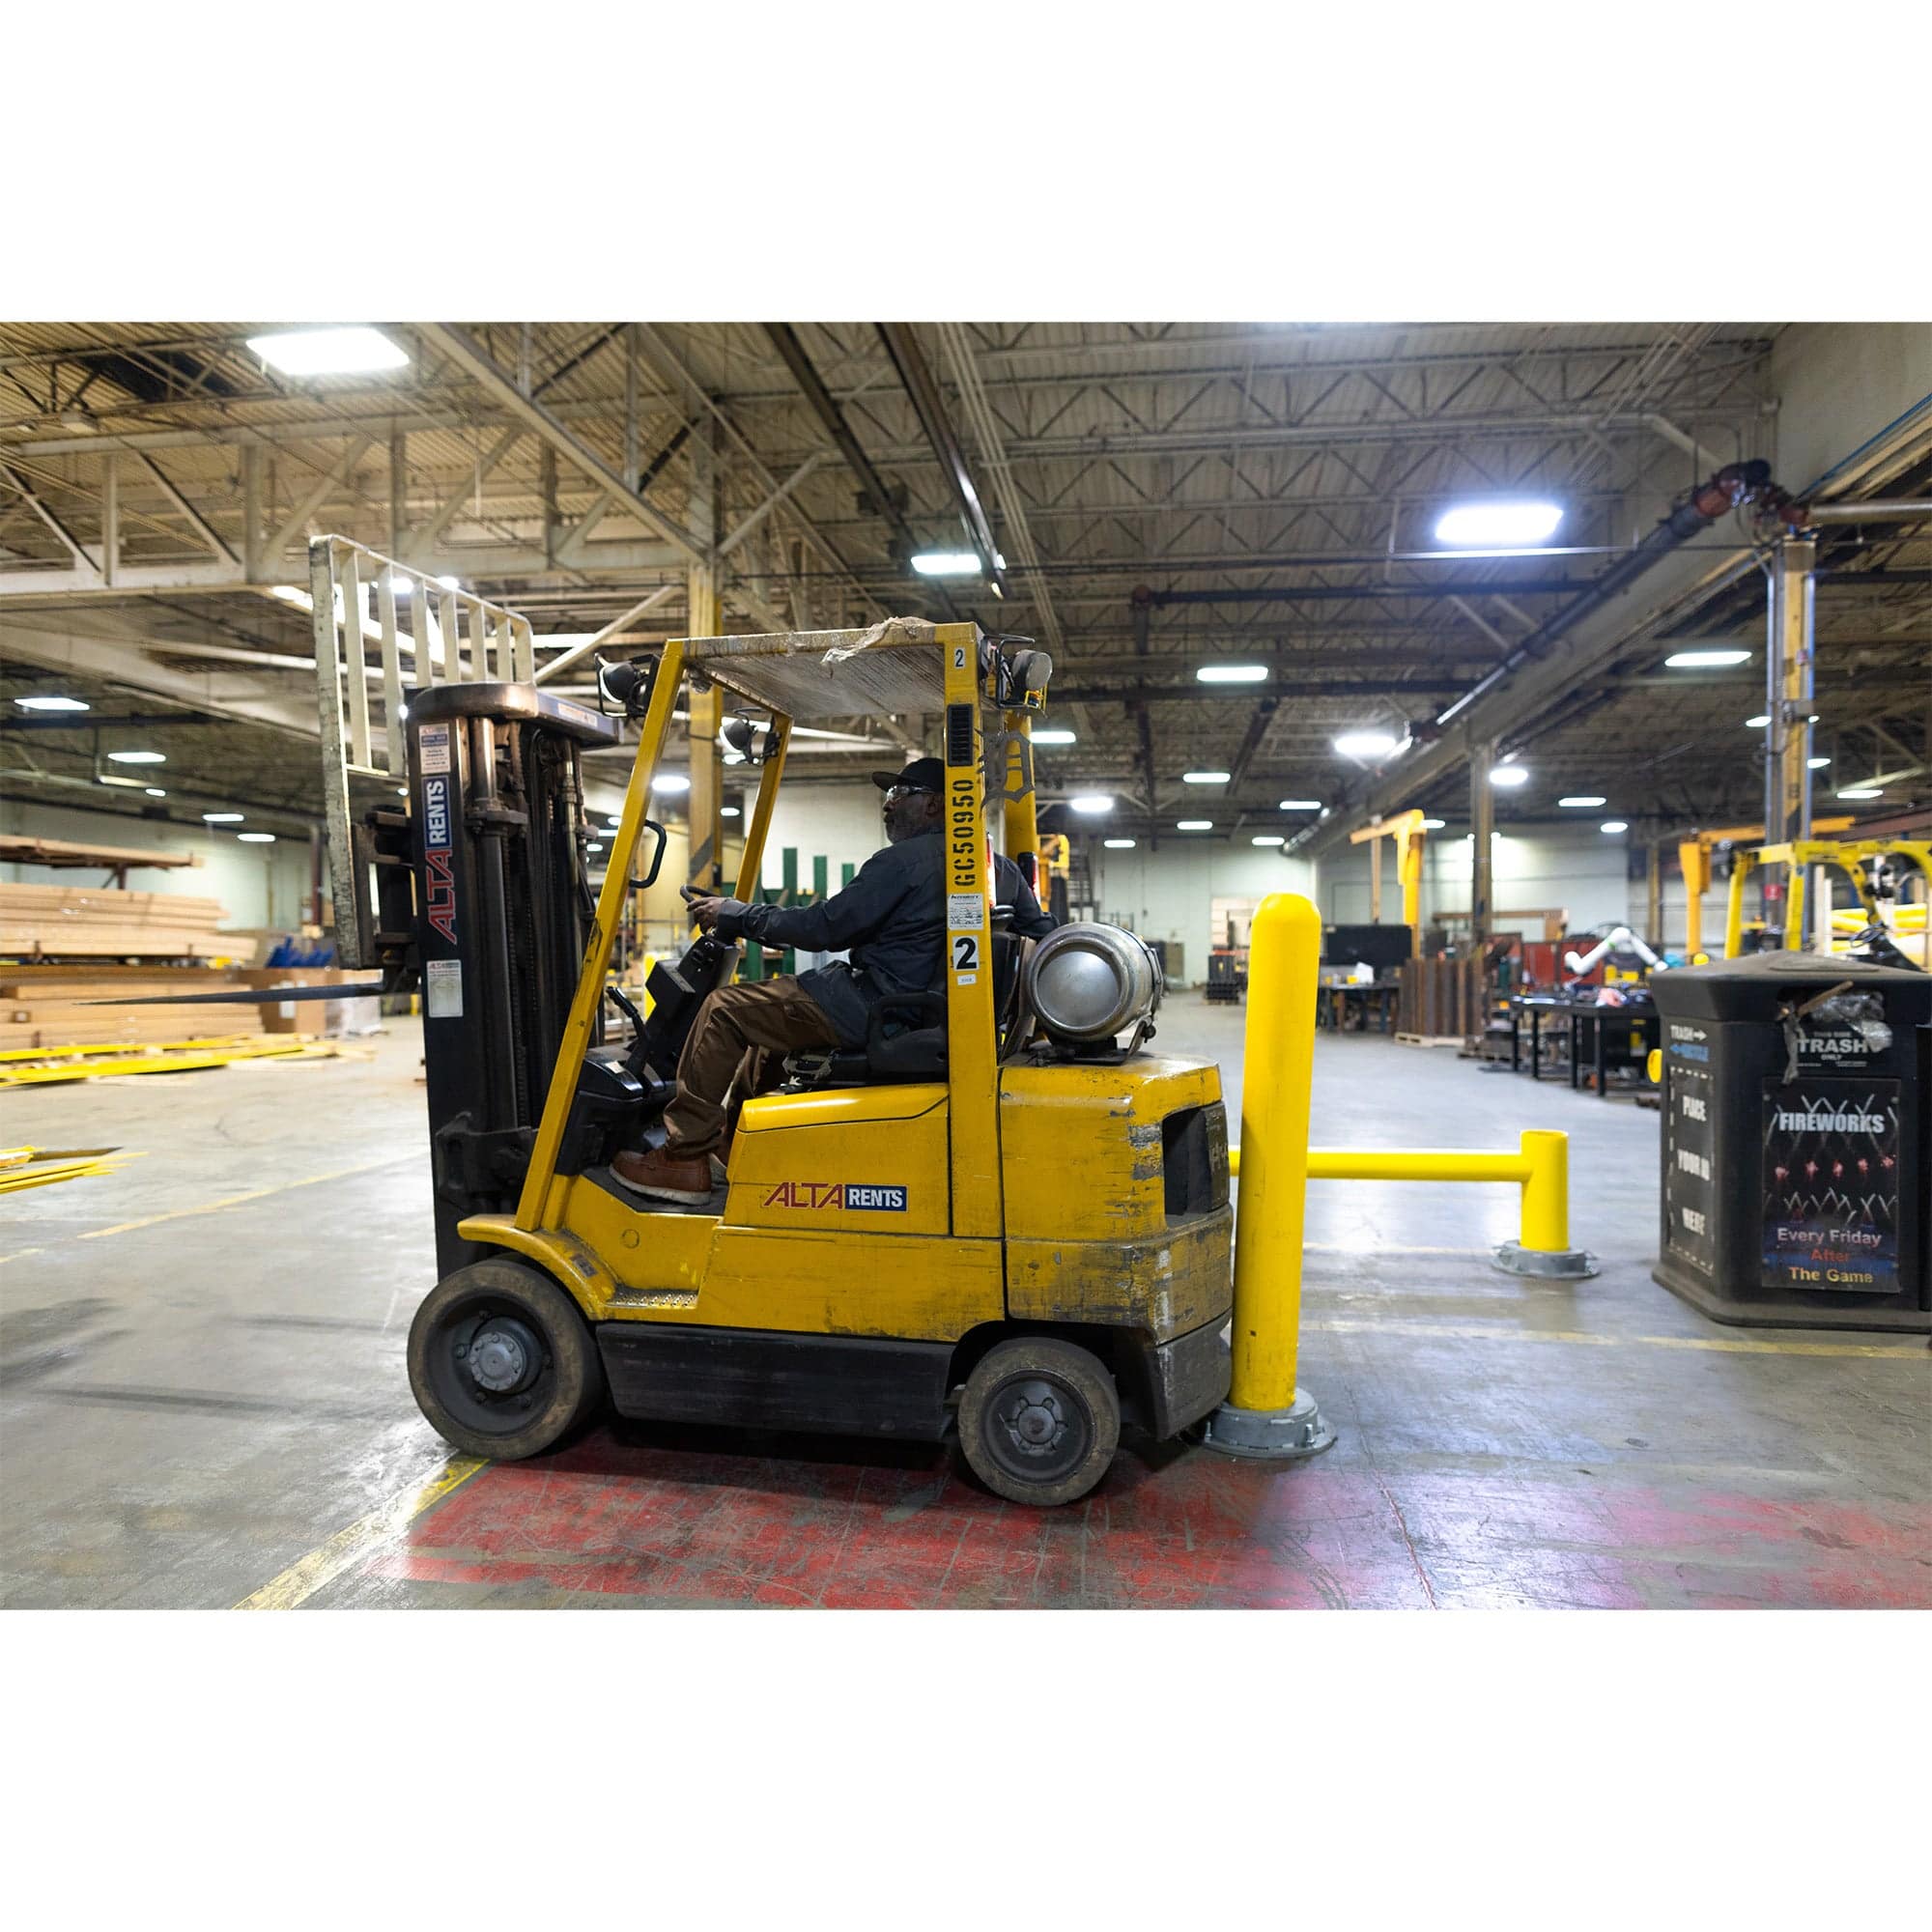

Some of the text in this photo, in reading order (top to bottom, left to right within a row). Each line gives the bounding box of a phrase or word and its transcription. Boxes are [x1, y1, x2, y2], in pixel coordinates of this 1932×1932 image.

[954, 649, 964, 667] 2
[426, 780, 446, 844] RENTS
[952, 779, 976, 887] GC50950
[425, 848, 457, 945] ALTA
[955, 937, 977, 969] 2
[1797, 1038, 1867, 1053] TRASH
[1778, 1113, 1886, 1133] FIREWORKS
[763, 1181, 903, 1209] ALTA RENTS
[1776, 1227, 1882, 1248] Every Friday
[1811, 1248, 1849, 1262] After
[1789, 1266, 1873, 1283] The Game
